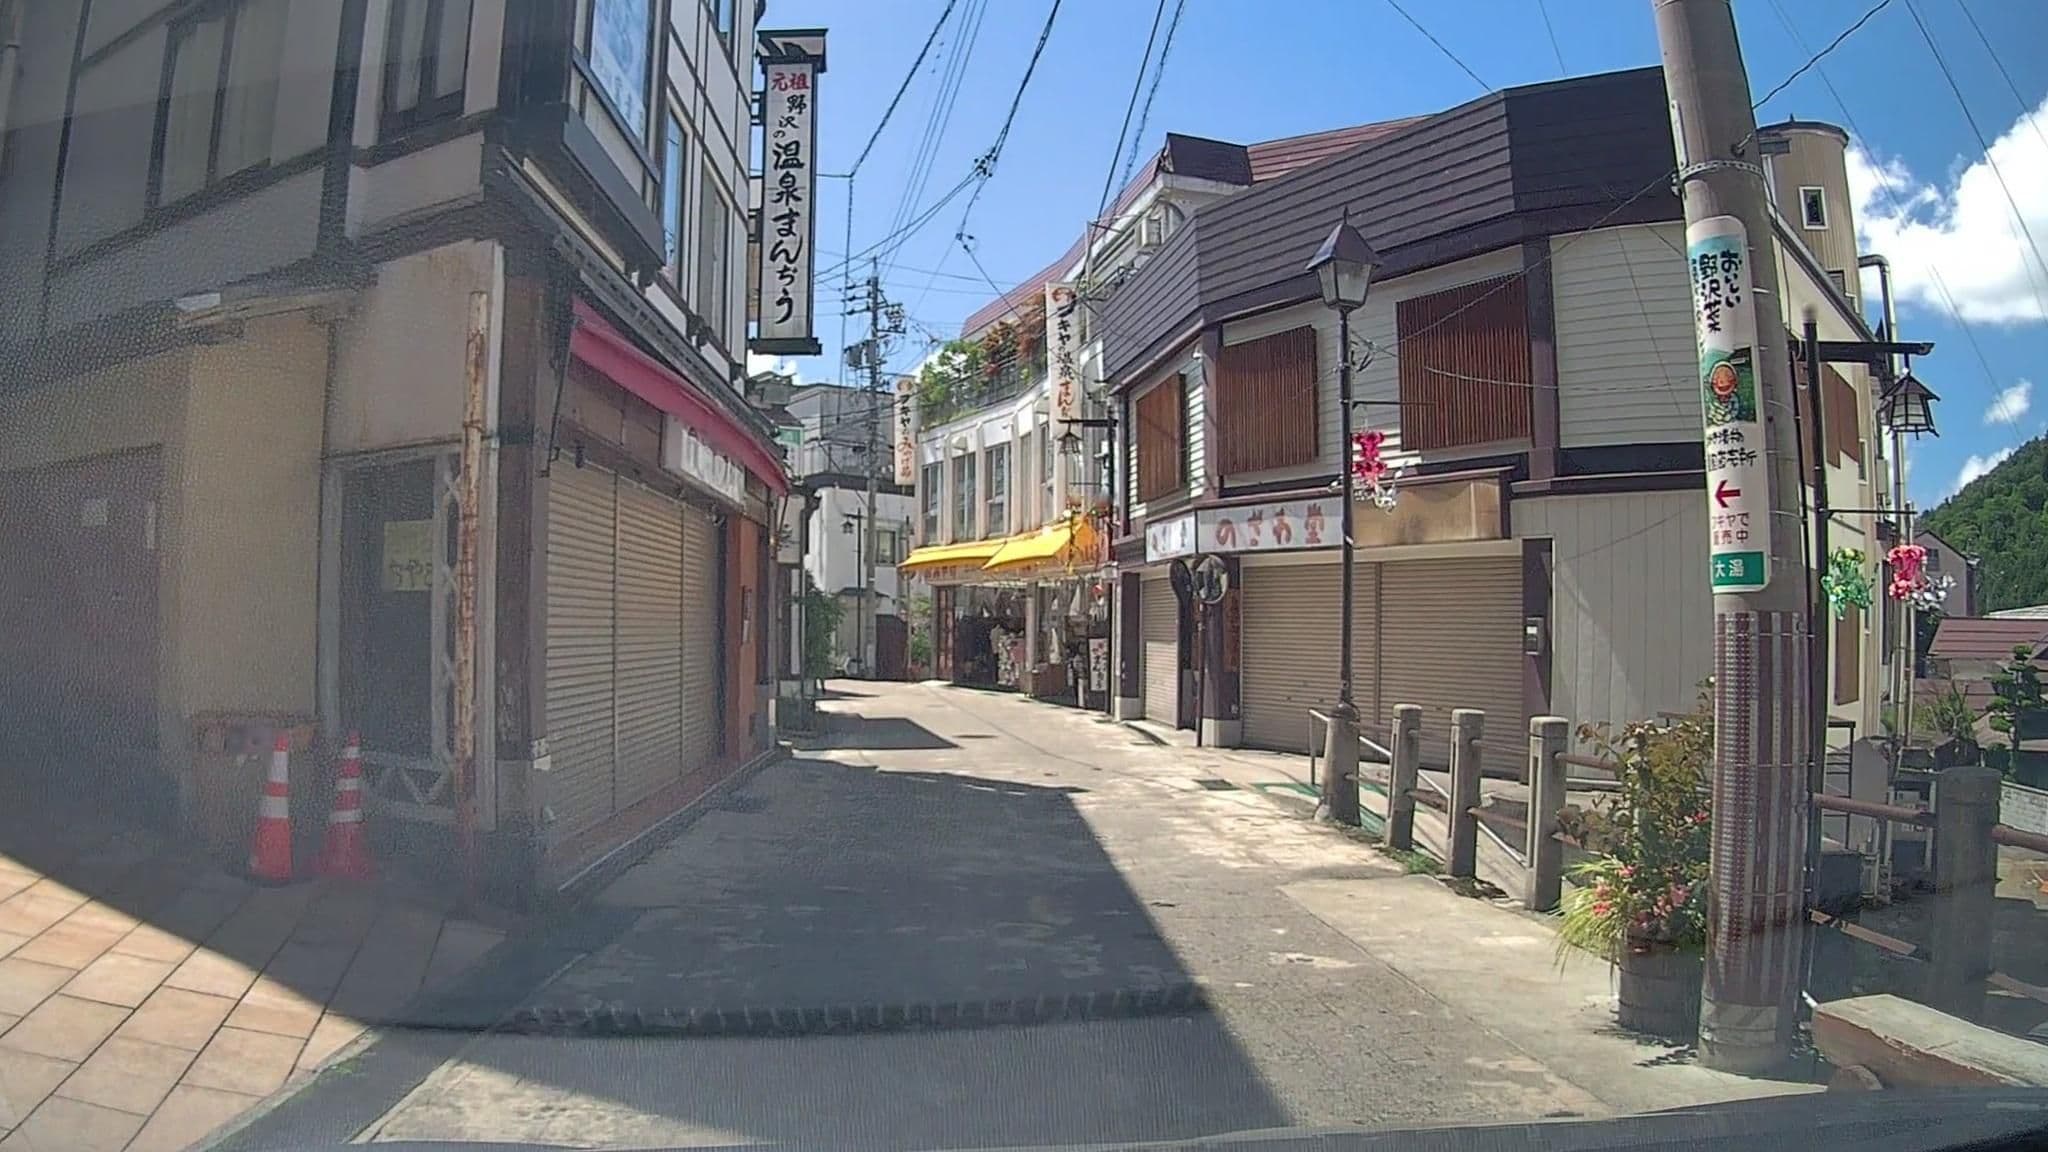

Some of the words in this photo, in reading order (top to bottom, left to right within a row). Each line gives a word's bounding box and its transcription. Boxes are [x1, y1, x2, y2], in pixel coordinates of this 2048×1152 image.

[770, 72, 810, 92] 元祖
[1699, 254, 1721, 334] 野沢菜
[1720, 249, 1742, 308] おいしい
[1215, 503, 1326, 548] のざわ堂
[1714, 559, 1744, 578] 大湯
